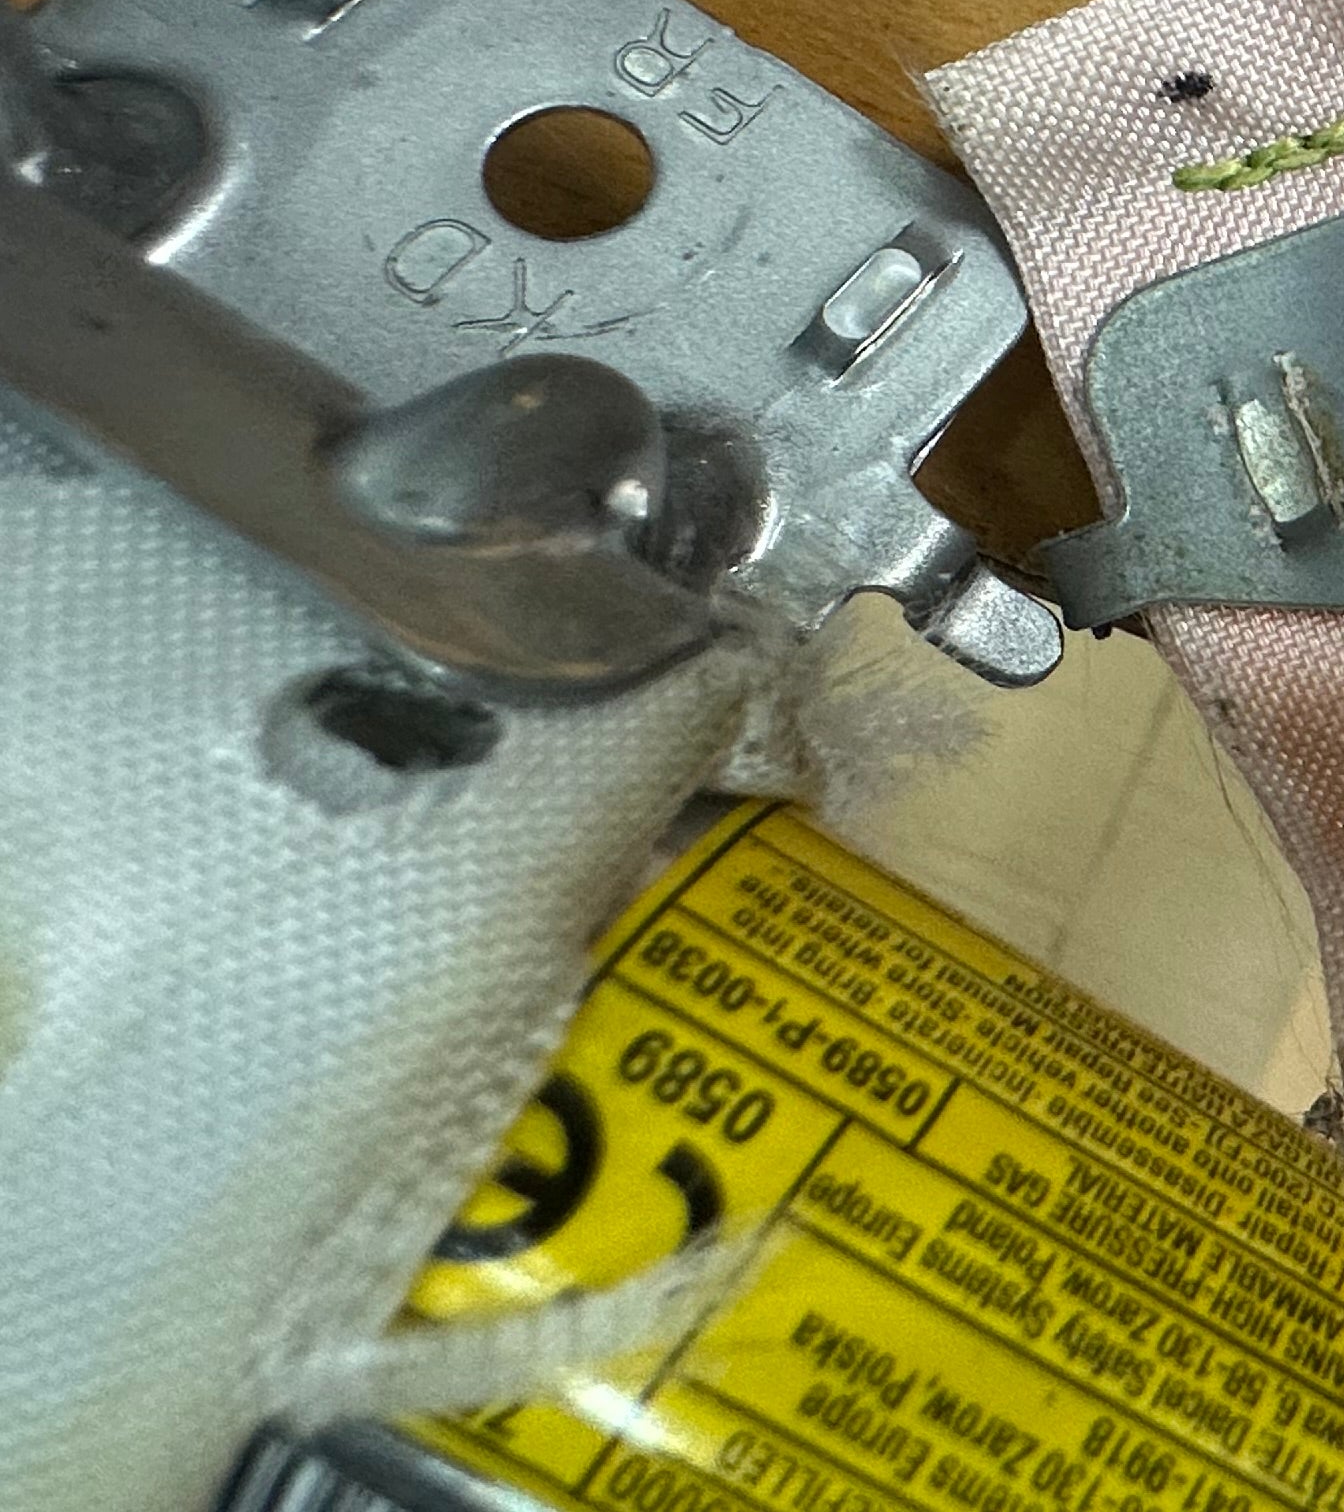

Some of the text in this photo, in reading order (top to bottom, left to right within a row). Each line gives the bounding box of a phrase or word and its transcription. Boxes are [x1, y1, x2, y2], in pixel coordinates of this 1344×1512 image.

[613, 8, 784, 146] FR
[383, 217, 576, 353] KD
[726, 905, 791, 956] into
[734, 873, 788, 916] the
[780, 902, 884, 973] where
[890, 936, 933, 972] for
[637, 926, 934, 1117] 0589-P1-0038
[932, 963, 1041, 1036] Manual
[614, 1024, 775, 1147] 0589
[970, 1017, 1080, 1092] vehicle
[1038, 1025, 1136, 1093] Repair
[1078, 1081, 1191, 1157] another
[801, 1165, 923, 1262] Europe
[983, 1151, 1050, 1207] GAS
[1056, 1156, 1206, 1257] MATERIAL
[1188, 1148, 1255, 1198] onto
[945, 1198, 1056, 1281] Poland
[1045, 1191, 1287, 1345] HIGH-PRESSURE
[914, 1234, 1057, 1339] Systems
[1053, 1261, 1160, 1343] Zarow,
[1050, 1310, 1158, 1397] Safety
[1154, 1322, 1268, 1406] 58-130
[786, 1310, 1155, 1512] -130 Zarow, Polska
[794, 1376, 931, 1480] Europe
[1150, 1375, 1252, 1453] Daicel
